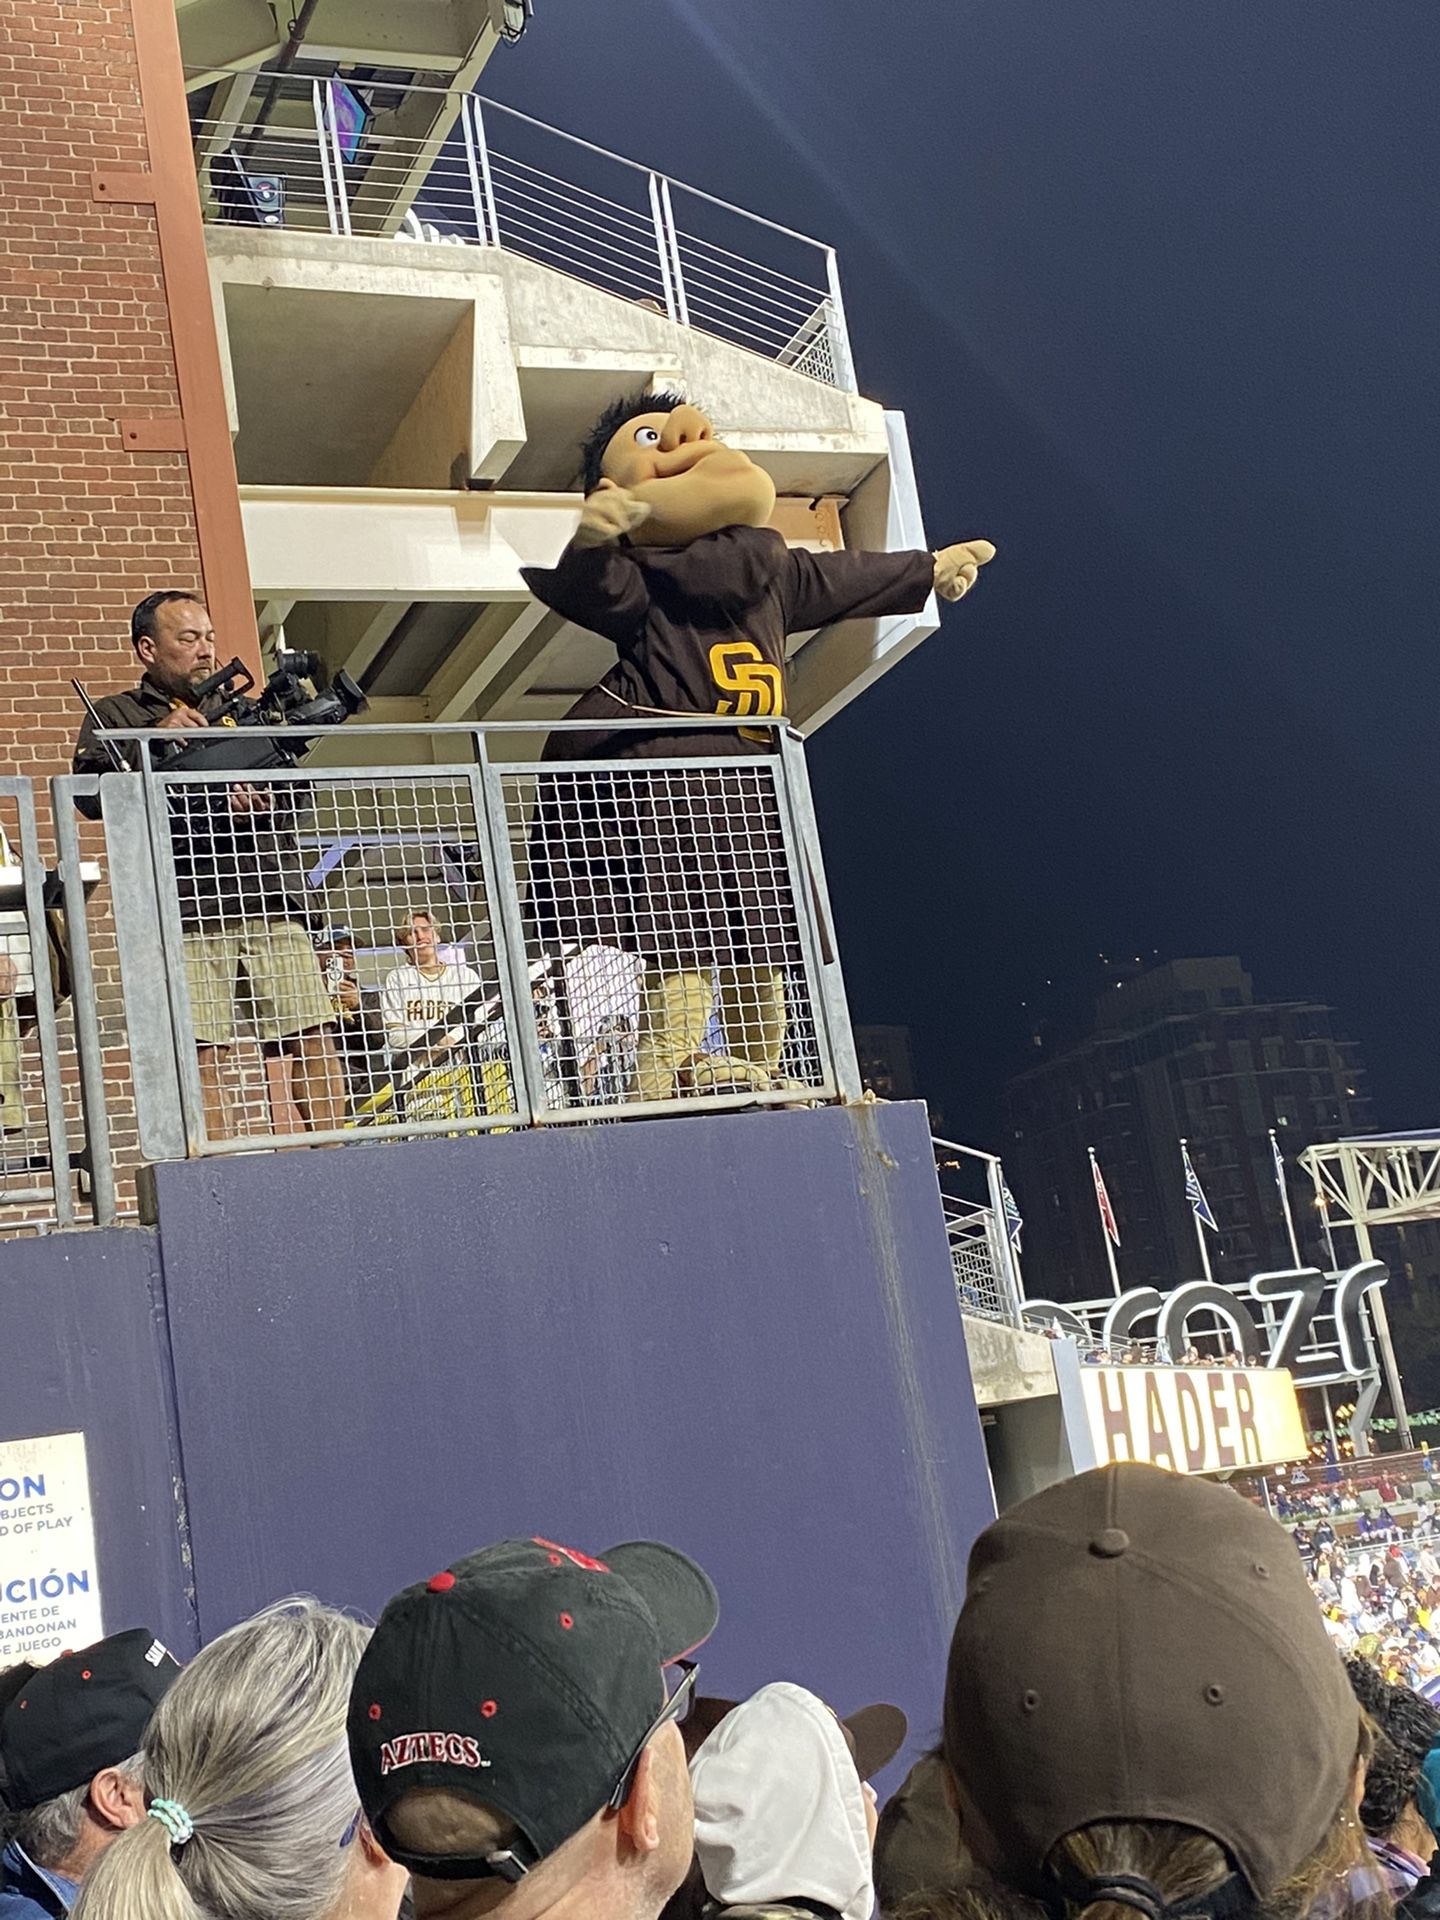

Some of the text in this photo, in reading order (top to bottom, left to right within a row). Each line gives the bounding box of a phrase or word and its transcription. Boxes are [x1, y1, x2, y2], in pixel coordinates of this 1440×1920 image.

[1098, 1371, 1263, 1474] HADER
[0, 1474, 46, 1501] ON
[13, 1521, 33, 1534] OF
[37, 1515, 73, 1531] PLAY
[0, 1567, 89, 1603] CIÓN
[1, 1605, 60, 1624] ENTE DE
[0, 1636, 61, 1655] E JUEGO
[380, 1731, 481, 1775] AZTECS
